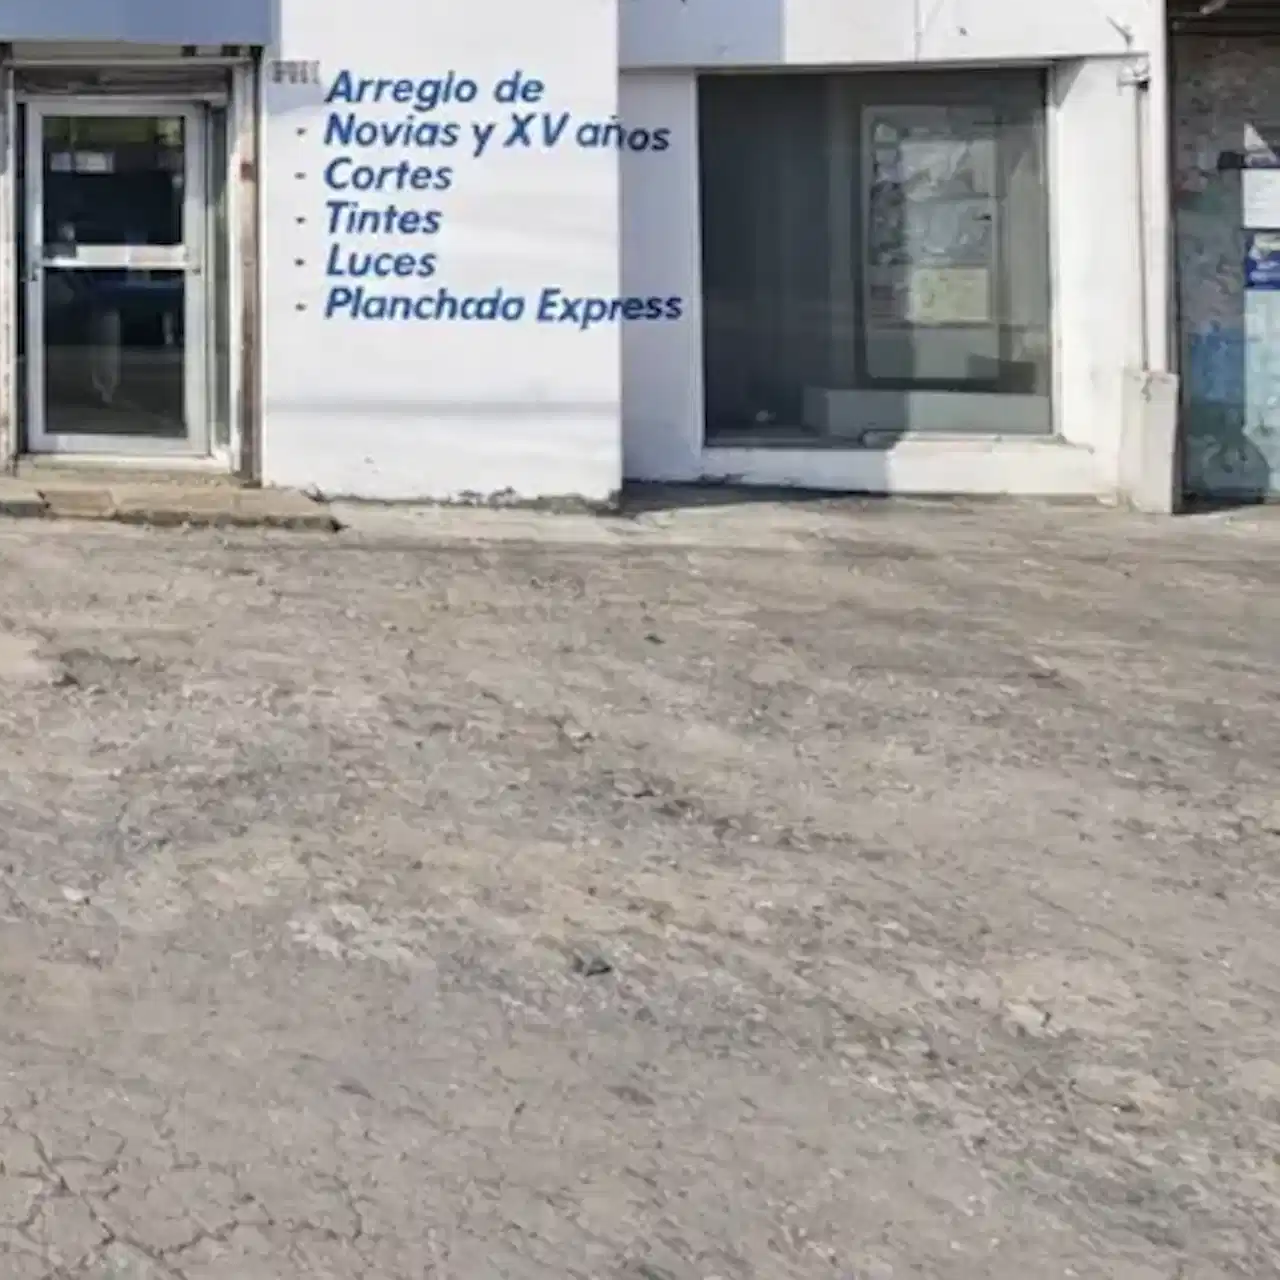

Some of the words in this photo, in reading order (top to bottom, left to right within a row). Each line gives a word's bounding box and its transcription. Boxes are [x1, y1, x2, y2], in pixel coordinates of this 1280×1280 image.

[325, 69, 478, 112] Arreglo
[493, 70, 545, 103] de
[323, 113, 460, 147] Novias
[472, 123, 496, 157] y
[324, 157, 452, 190] Cortes
[326, 201, 442, 234] Tintes
[326, 244, 436, 277] Luces
[536, 287, 683, 332] Express
